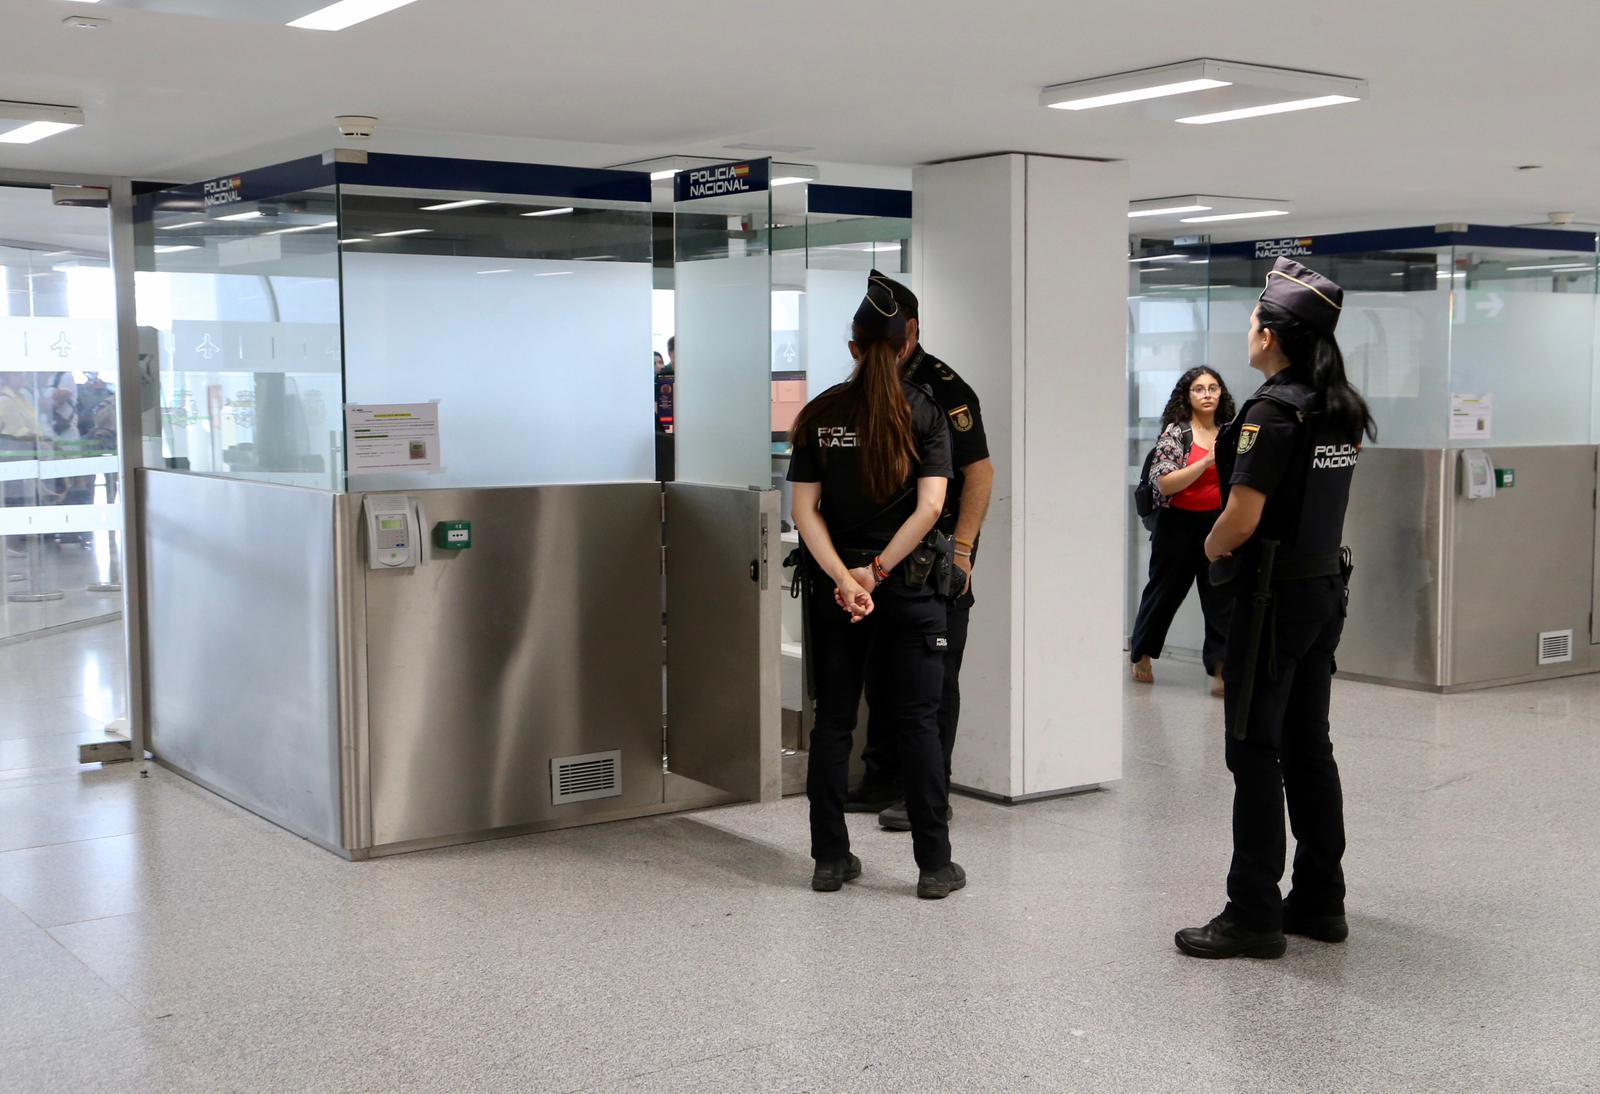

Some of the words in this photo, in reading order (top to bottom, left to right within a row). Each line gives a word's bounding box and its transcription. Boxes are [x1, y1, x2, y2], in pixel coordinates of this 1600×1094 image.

[690, 178, 749, 197] NACIONAL
[204, 191, 242, 206] NACIONAL
[1255, 247, 1312, 258] NACIONAL
